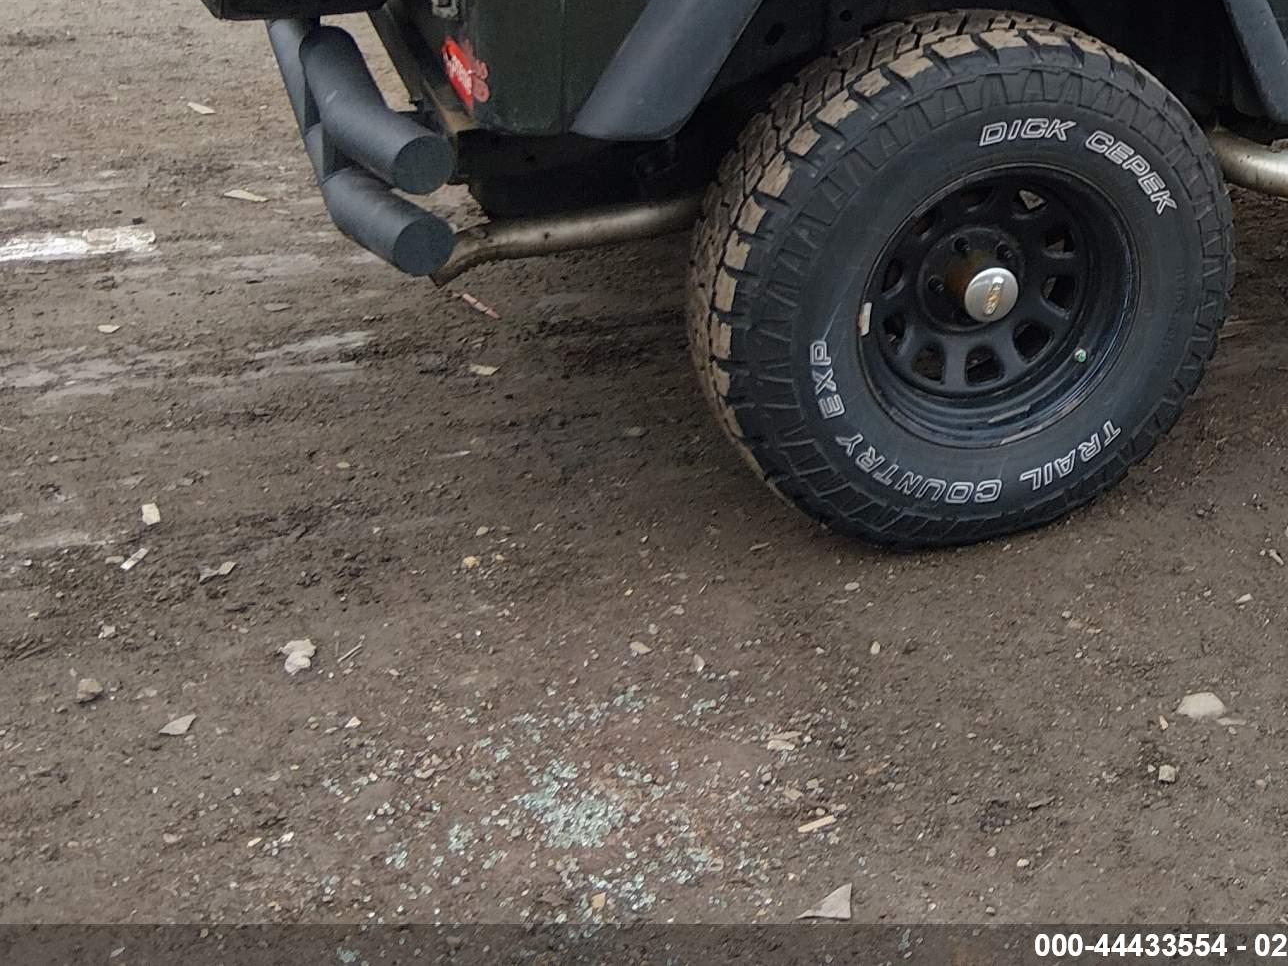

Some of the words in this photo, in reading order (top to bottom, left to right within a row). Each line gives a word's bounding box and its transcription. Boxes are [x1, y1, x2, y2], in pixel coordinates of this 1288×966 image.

[979, 118, 1077, 147] DICK
[1085, 130, 1178, 215] CEPEK
[809, 339, 846, 420] EXP
[835, 433, 1003, 505] COUNTRY
[1019, 420, 1123, 492] TRAIL
